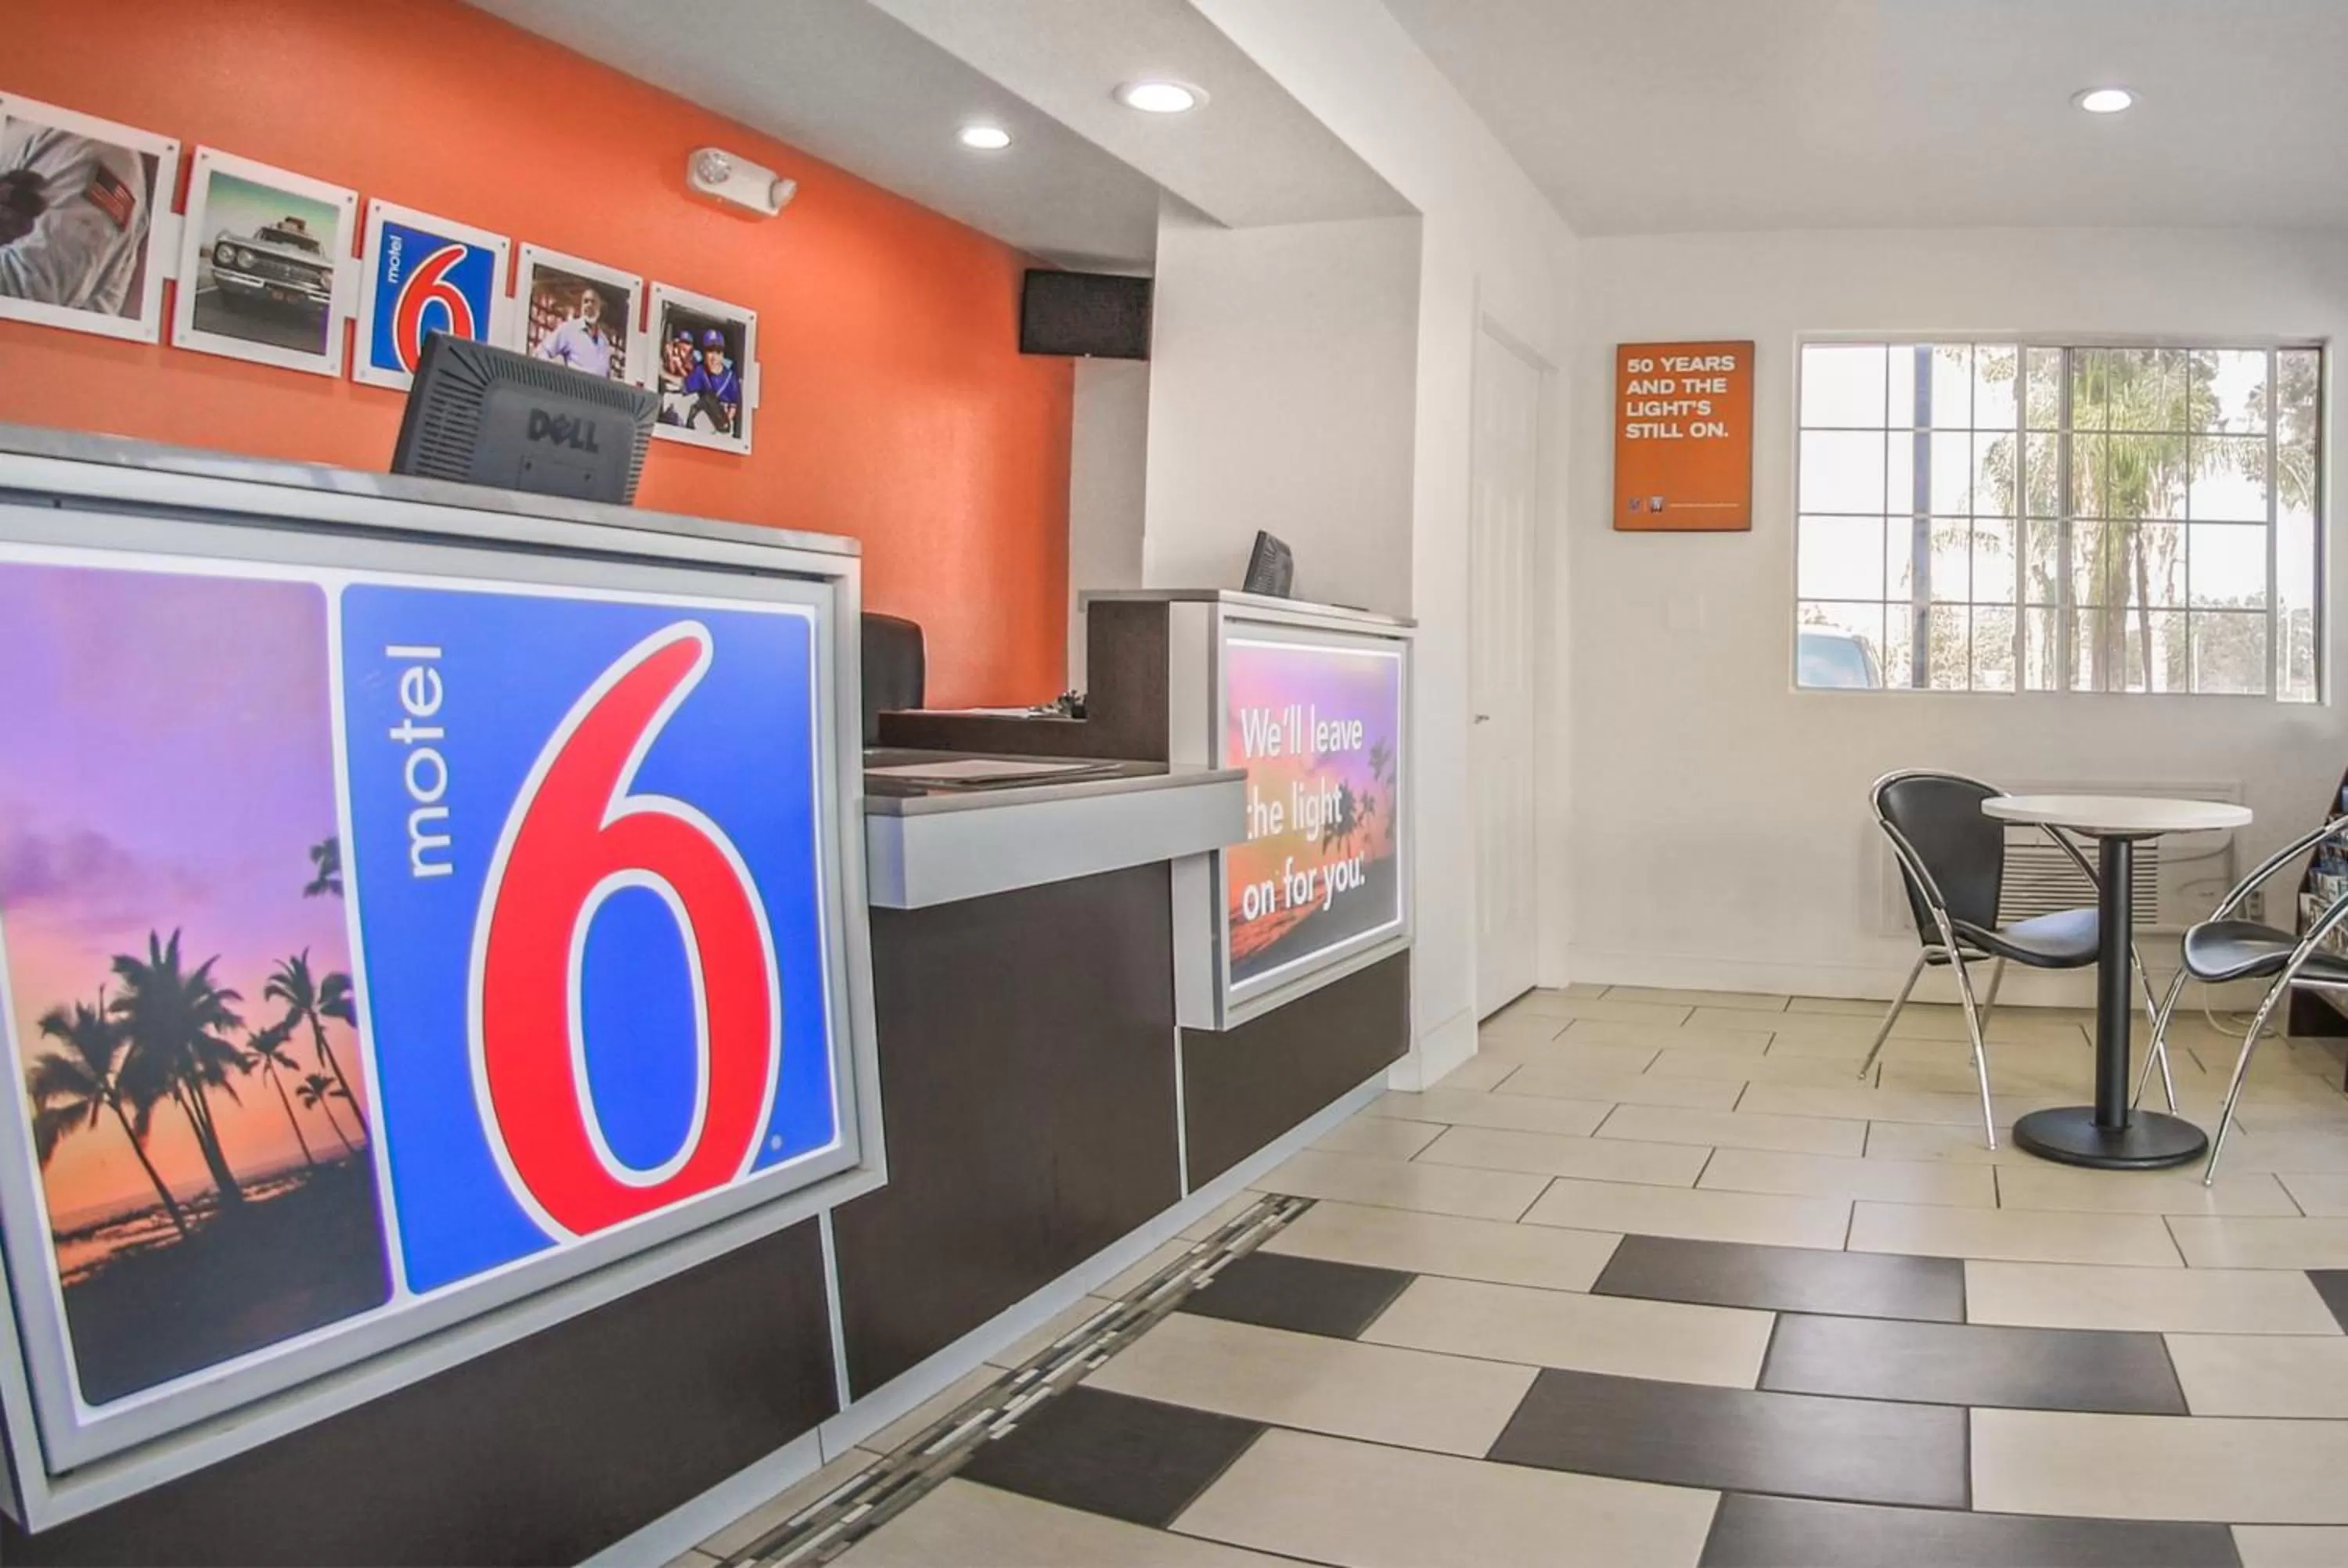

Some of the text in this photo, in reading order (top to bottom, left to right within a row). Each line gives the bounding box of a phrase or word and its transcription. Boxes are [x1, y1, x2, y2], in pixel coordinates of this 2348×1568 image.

[387, 235, 402, 284] motel
[393, 243, 476, 376] 6
[1626, 377, 1728, 395] AND THE
[1627, 354, 1736, 373] 50 YEARS
[527, 408, 600, 455] DELL
[1626, 400, 1712, 417] LIGHT'S
[1626, 421, 1729, 439] STILL ON.
[1240, 703, 1363, 758] We'll leave
[385, 645, 454, 878] motel
[1291, 775, 1343, 843] light
[1243, 879, 1275, 921] on
[1283, 856, 1317, 909] for
[467, 619, 782, 1246] 6
